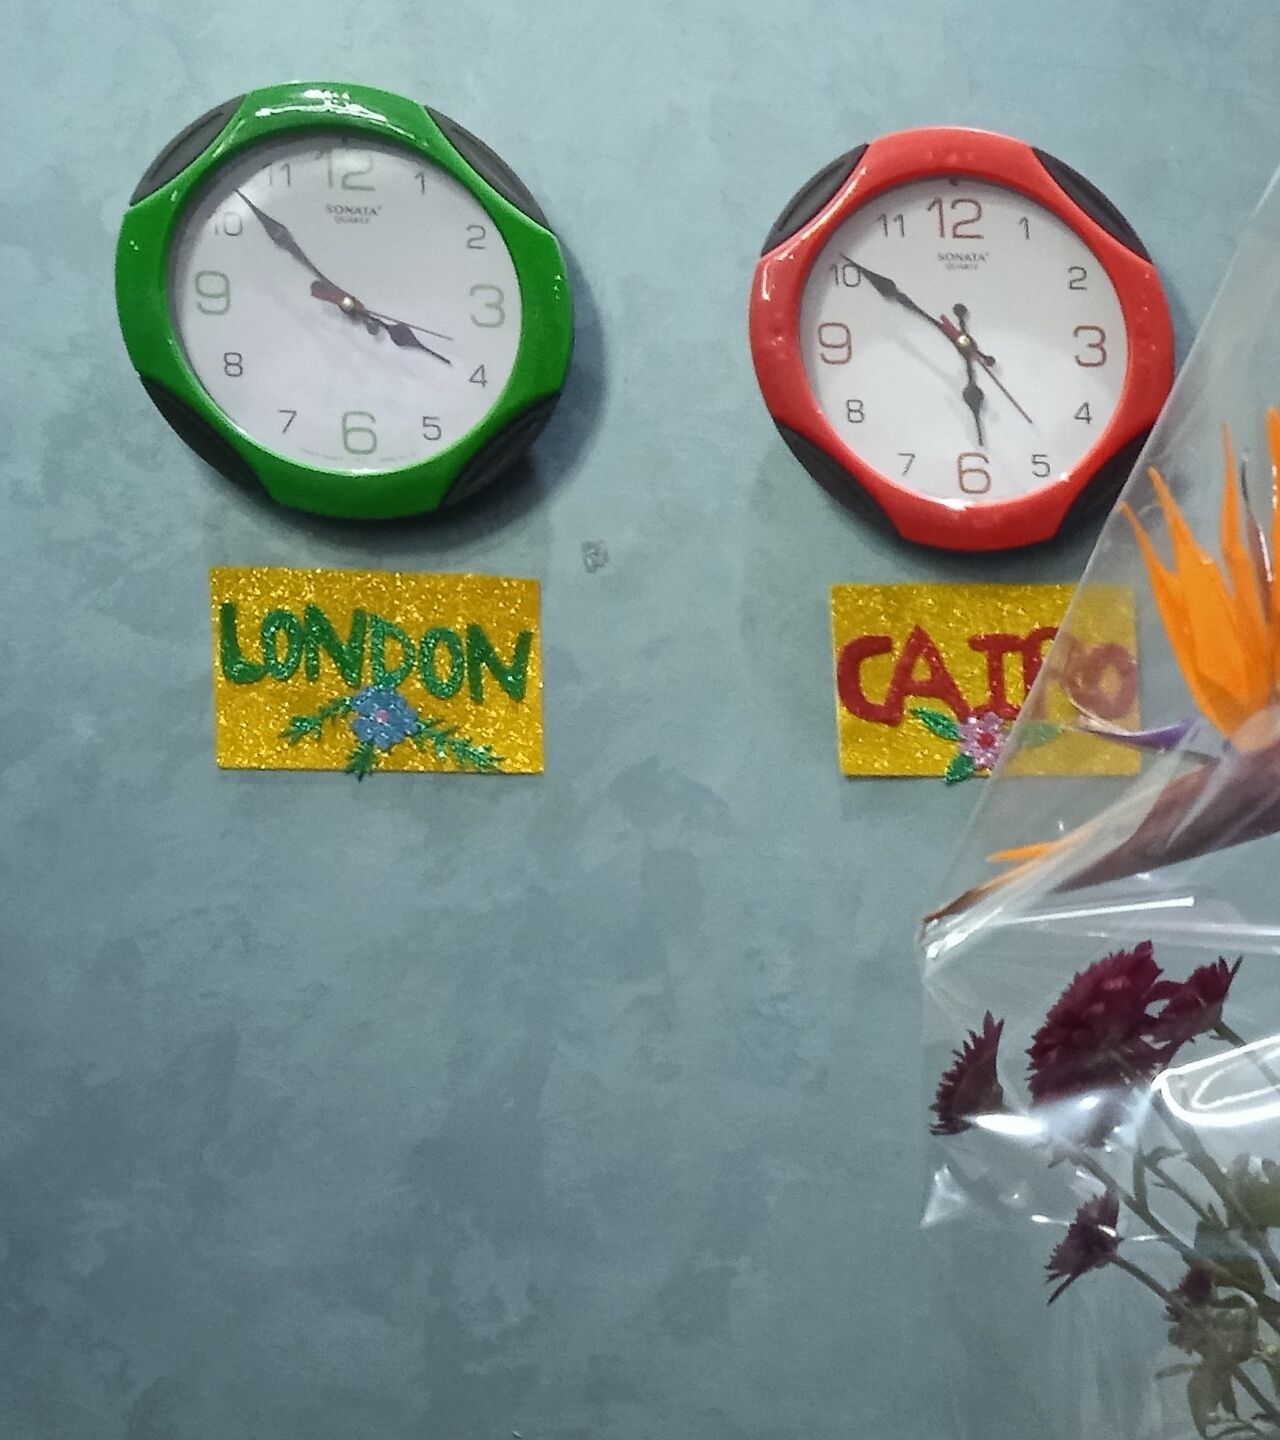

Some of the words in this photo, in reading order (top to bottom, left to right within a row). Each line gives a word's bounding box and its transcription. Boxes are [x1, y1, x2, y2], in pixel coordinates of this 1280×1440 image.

[267, 161, 291, 187] 11
[314, 149, 376, 191] 12
[415, 172, 427, 194] 1
[326, 204, 378, 216] SONATA
[926, 198, 985, 240] 12
[213, 212, 244, 236] 10
[878, 213, 906, 237] 11
[1019, 216, 1030, 240] 1
[466, 224, 487, 250] 2
[937, 252, 986, 261] SONATA
[828, 264, 861, 288] 10
[1067, 266, 1088, 291] 2
[195, 270, 231, 316] 9
[469, 284, 506, 329] 3
[817, 322, 853, 365] 9
[1073, 325, 1107, 367] 3
[222, 352, 244, 378] 8
[468, 364, 488, 388] 4
[278, 409, 298, 434] 7
[846, 399, 866, 424] 8
[1073, 401, 1093, 424] 4
[341, 411, 378, 456] 6
[421, 416, 442, 442] 5
[897, 453, 916, 477] 7
[956, 452, 992, 494] 6
[1030, 454, 1051, 478] 5
[219, 602, 534, 704] LONDON
[836, 625, 1139, 726] CAIRO
